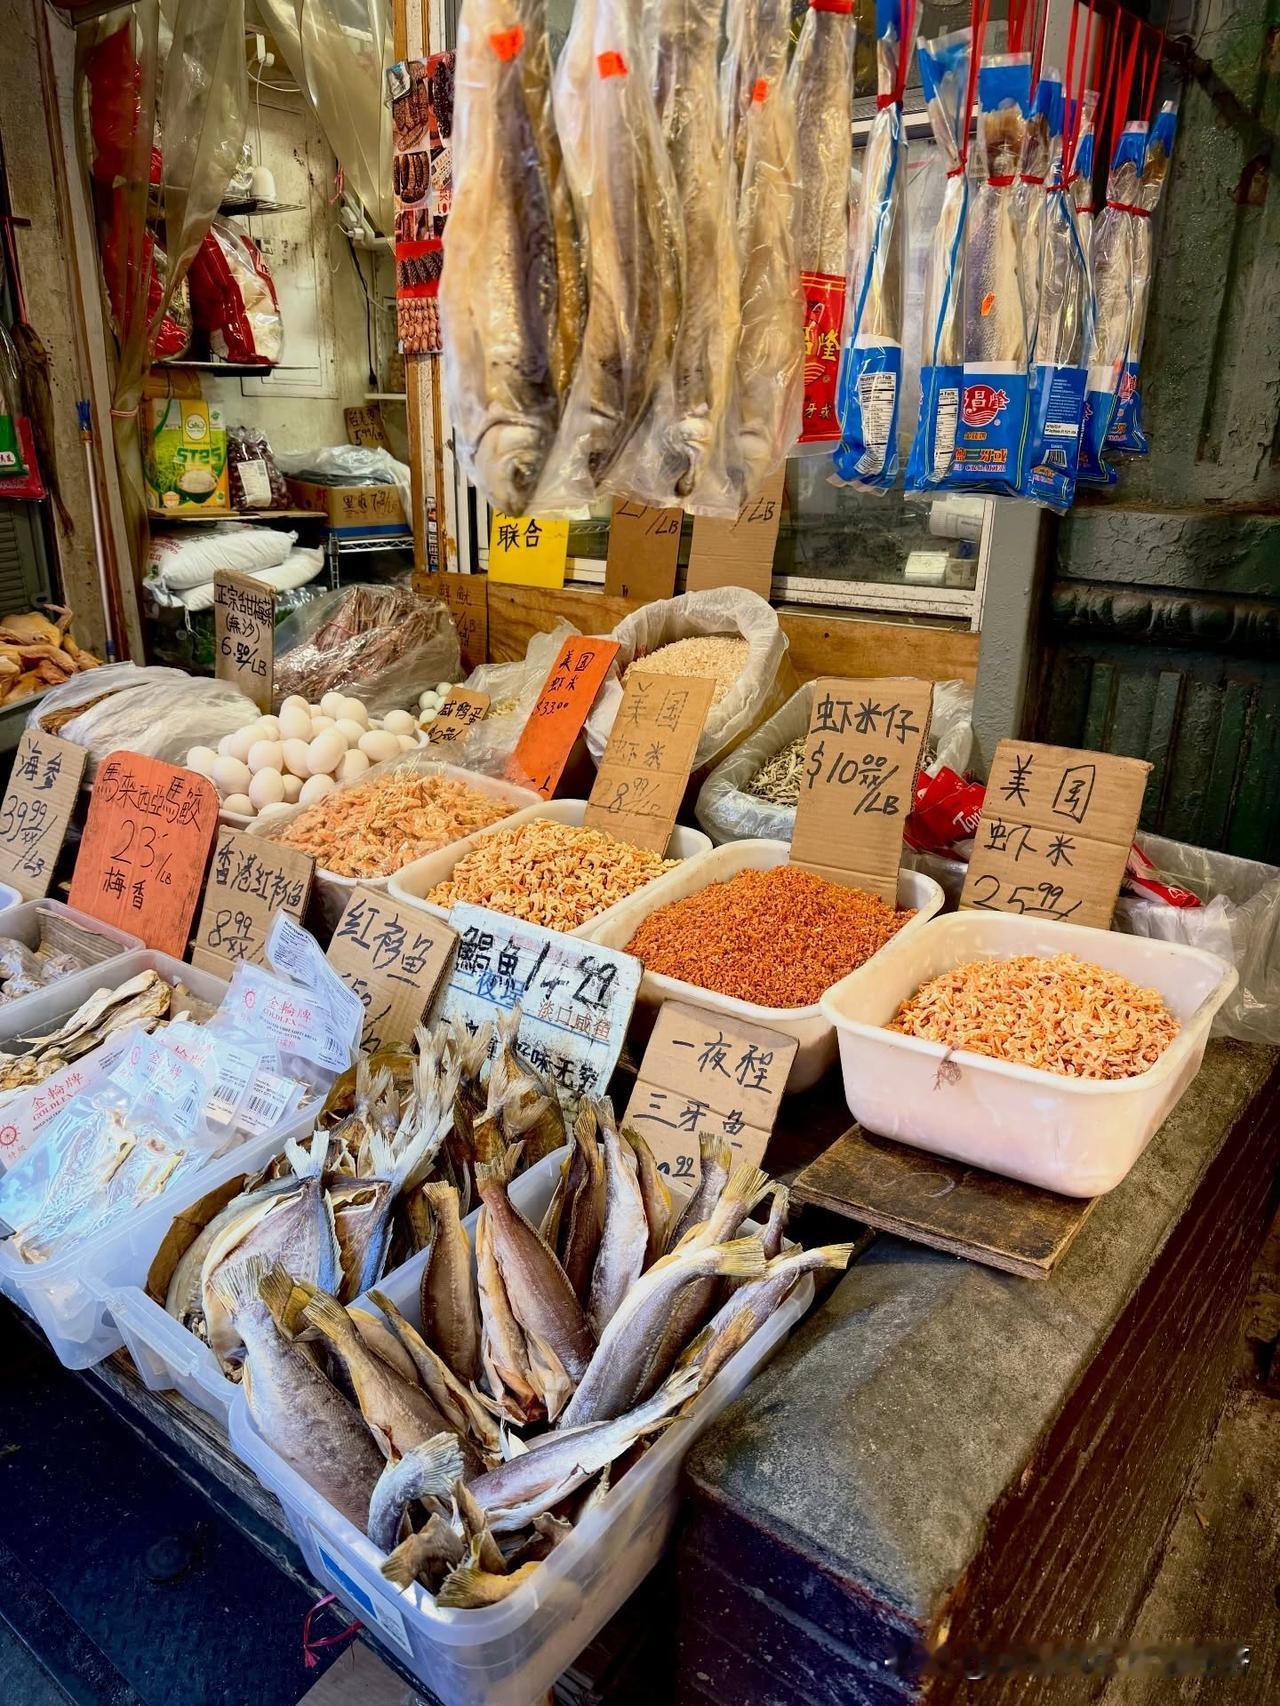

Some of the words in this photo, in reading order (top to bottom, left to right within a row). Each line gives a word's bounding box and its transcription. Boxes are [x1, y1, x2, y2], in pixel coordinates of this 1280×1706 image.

[175, 446, 222, 464] ST25
[497, 518, 543, 552] 联合
[810, 692, 920, 745] 虾米仔
[1000, 754, 1096, 824] 美国
[984, 817, 1076, 867] 虾米
[103, 866, 146, 910] 梅香
